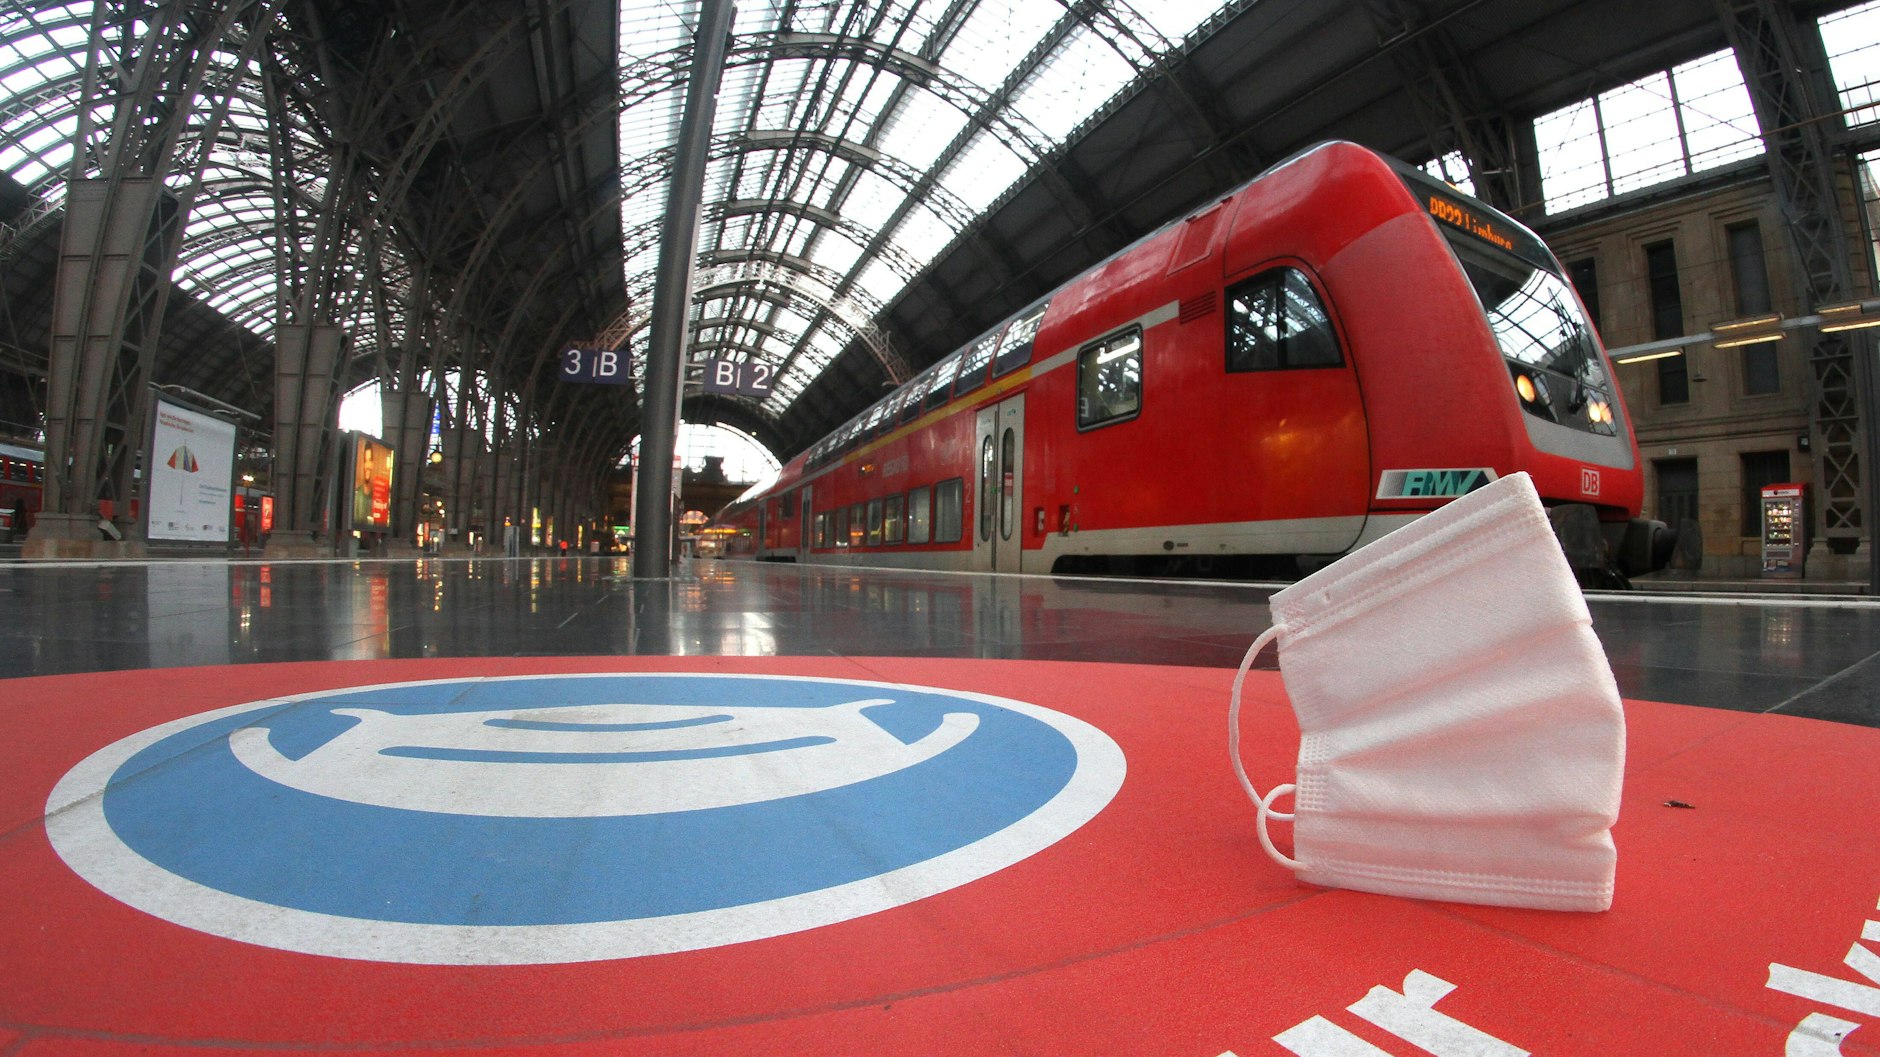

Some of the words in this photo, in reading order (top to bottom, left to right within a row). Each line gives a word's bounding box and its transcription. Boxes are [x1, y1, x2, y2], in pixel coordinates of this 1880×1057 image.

[565, 349, 582, 375] 3
[599, 352, 618, 377] B
[715, 361, 734, 386] B
[752, 364, 770, 389] 2
[1583, 472, 1599, 492] DB
